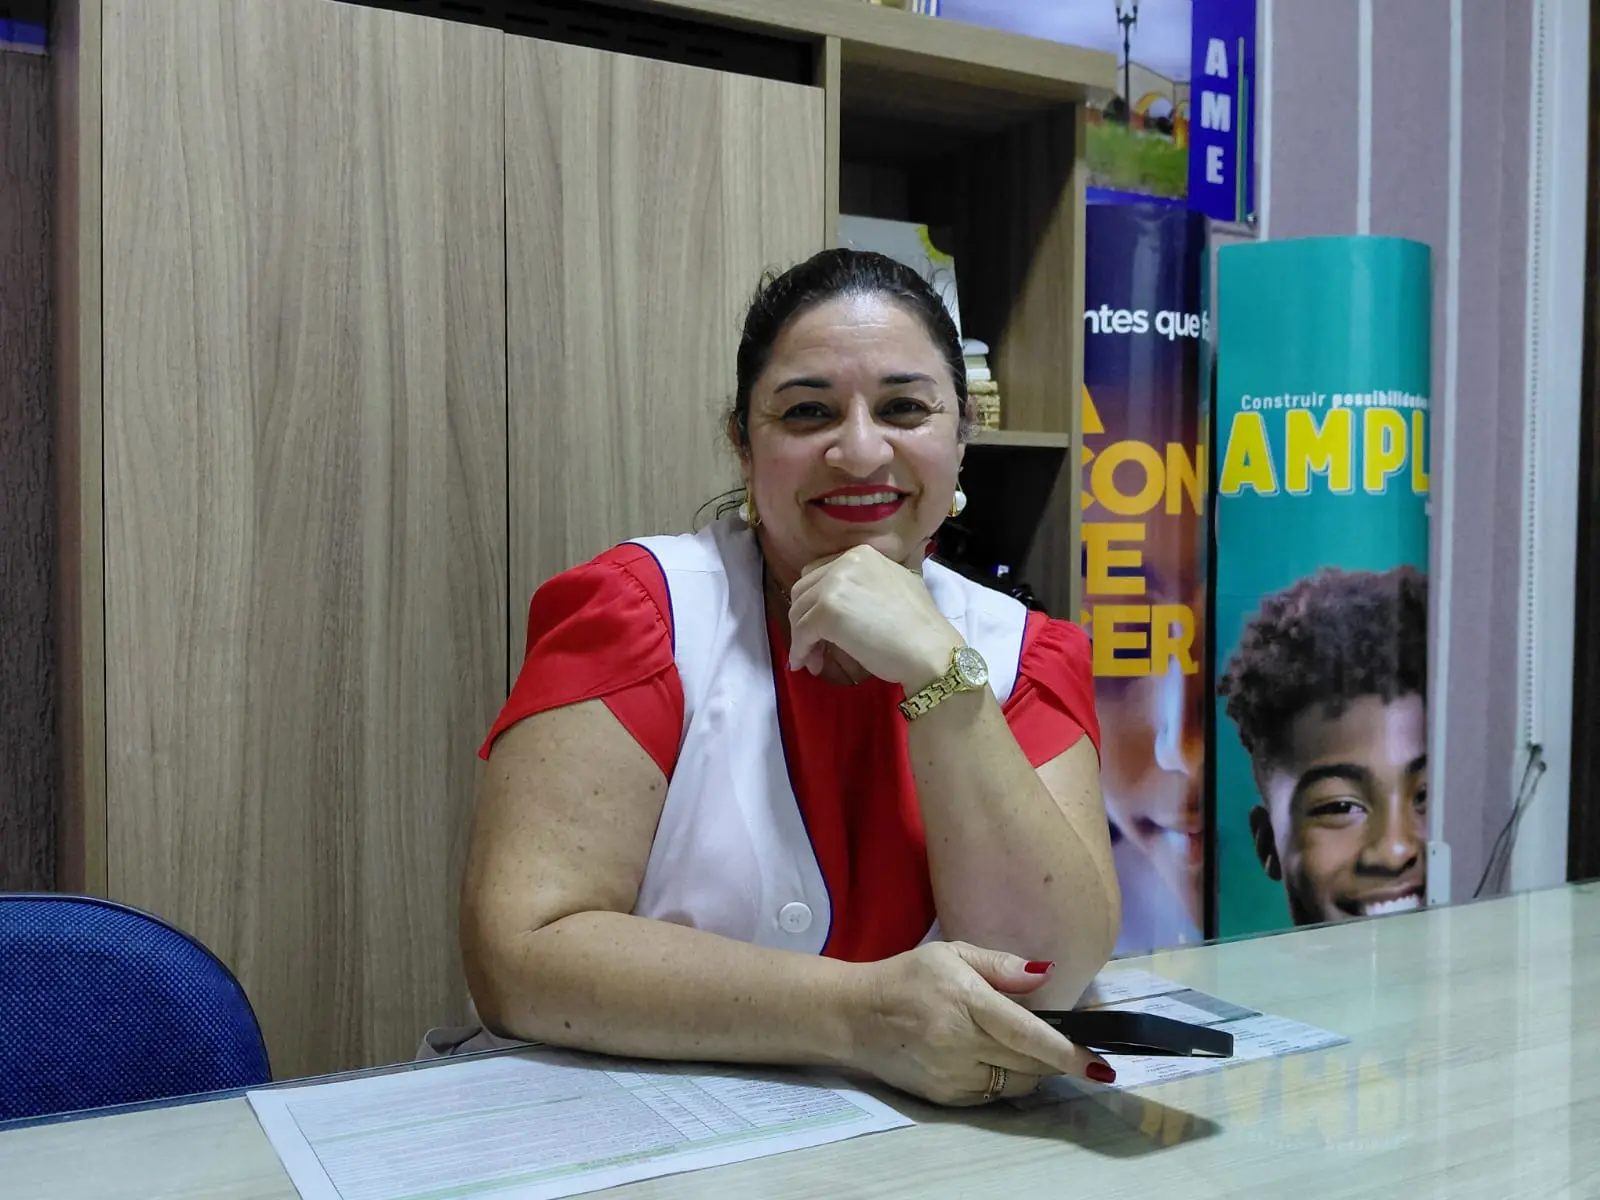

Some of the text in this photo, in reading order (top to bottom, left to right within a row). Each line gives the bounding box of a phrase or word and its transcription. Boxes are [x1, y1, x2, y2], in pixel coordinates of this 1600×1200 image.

[1201, 38, 1231, 184] AME
[1155, 310, 1200, 341] que
[1241, 391, 1326, 410] Construir
[1082, 440, 1204, 516] ON
[1219, 407, 1429, 498] AMPL
[1081, 522, 1146, 594] E
[1081, 604, 1199, 677] ER
